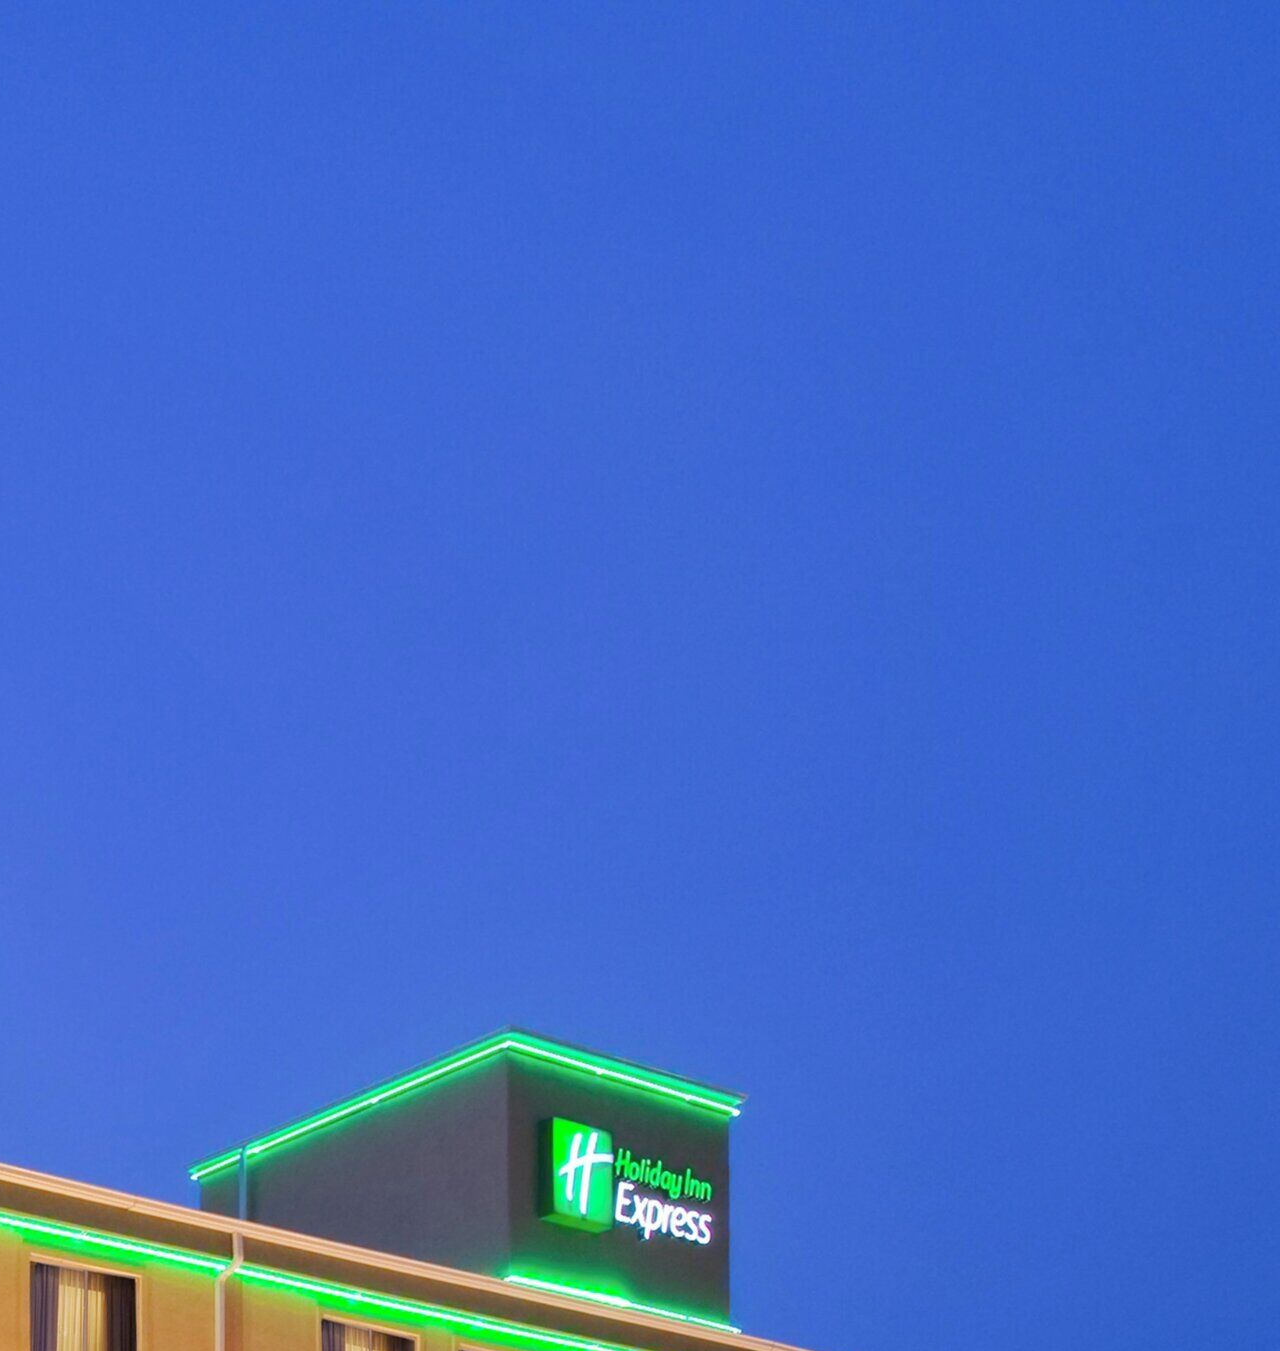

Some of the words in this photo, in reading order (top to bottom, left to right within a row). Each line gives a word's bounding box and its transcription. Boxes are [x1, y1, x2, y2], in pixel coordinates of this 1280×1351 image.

[615, 1148, 684, 1199] Holiday
[684, 1168, 712, 1201] Inn
[614, 1180, 713, 1245] Express
